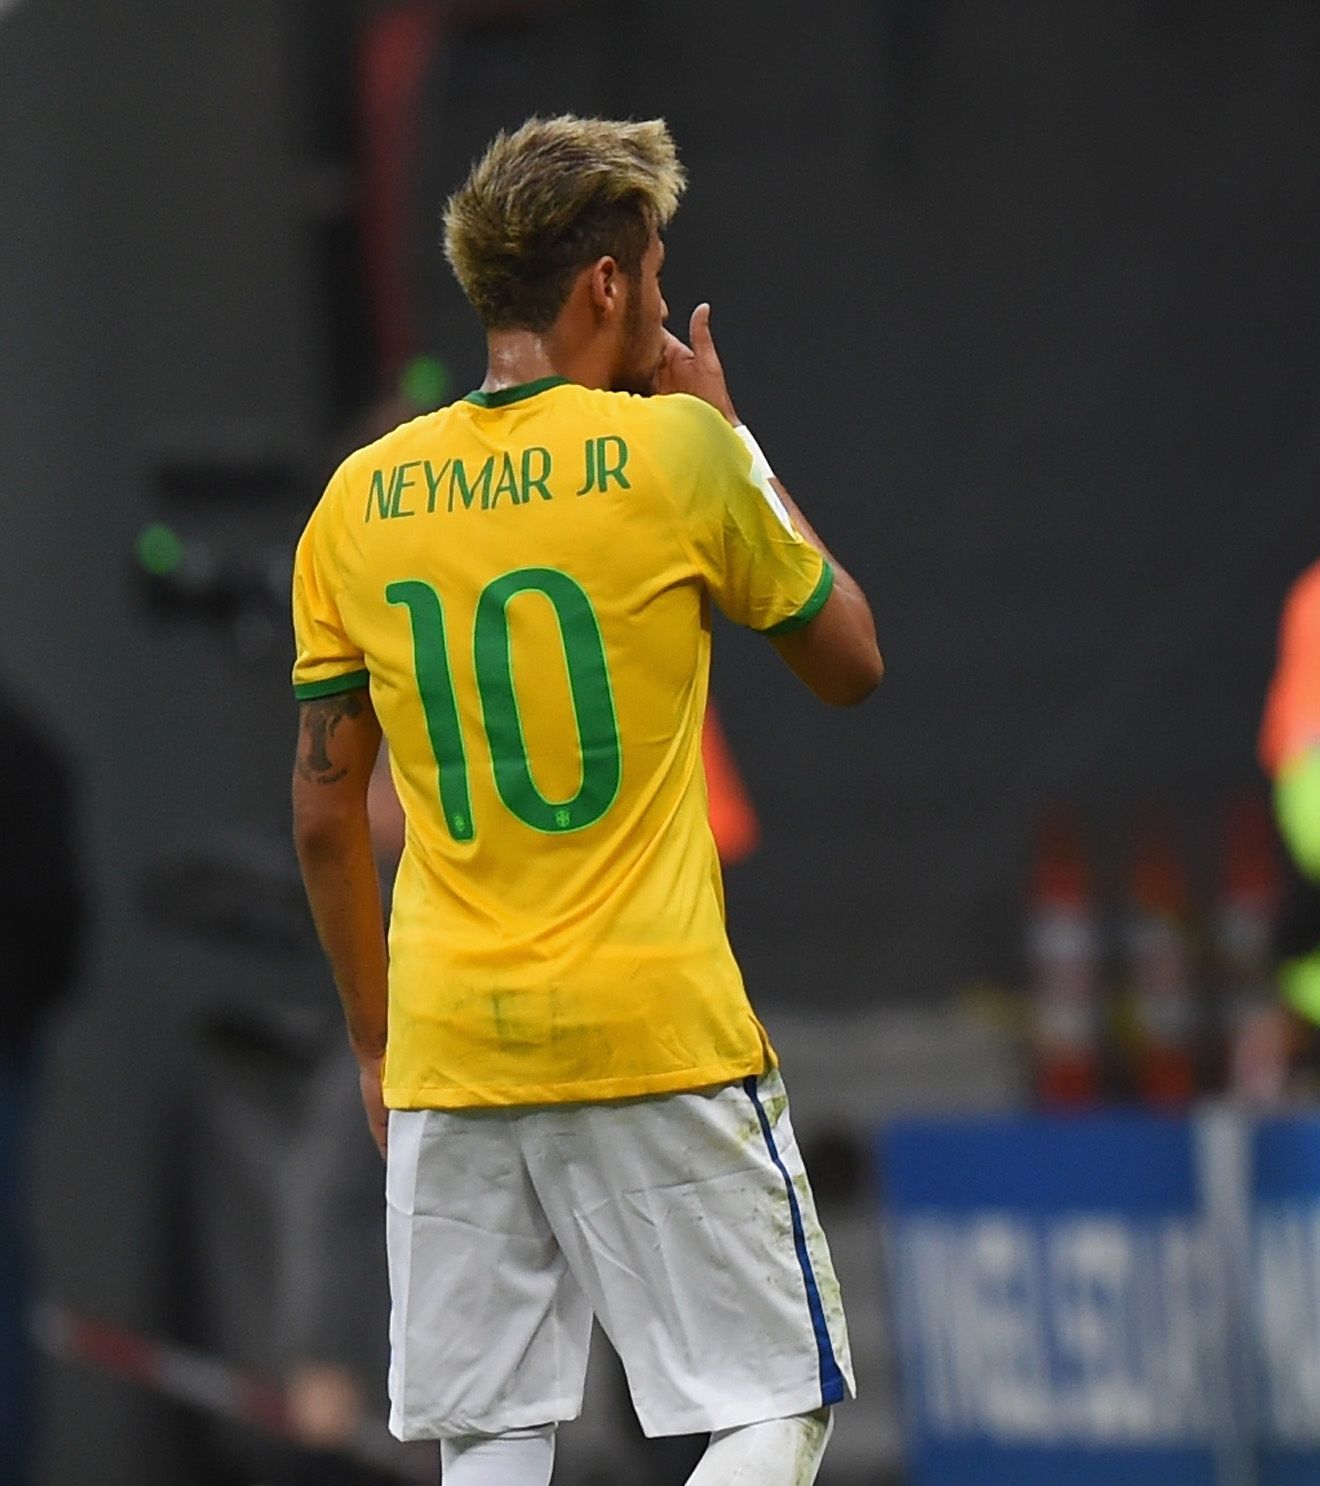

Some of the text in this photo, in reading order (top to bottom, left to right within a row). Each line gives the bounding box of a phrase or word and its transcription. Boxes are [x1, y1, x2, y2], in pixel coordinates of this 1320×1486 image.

[365, 435, 631, 523] NEYMAR JR
[385, 565, 623, 844] 10
